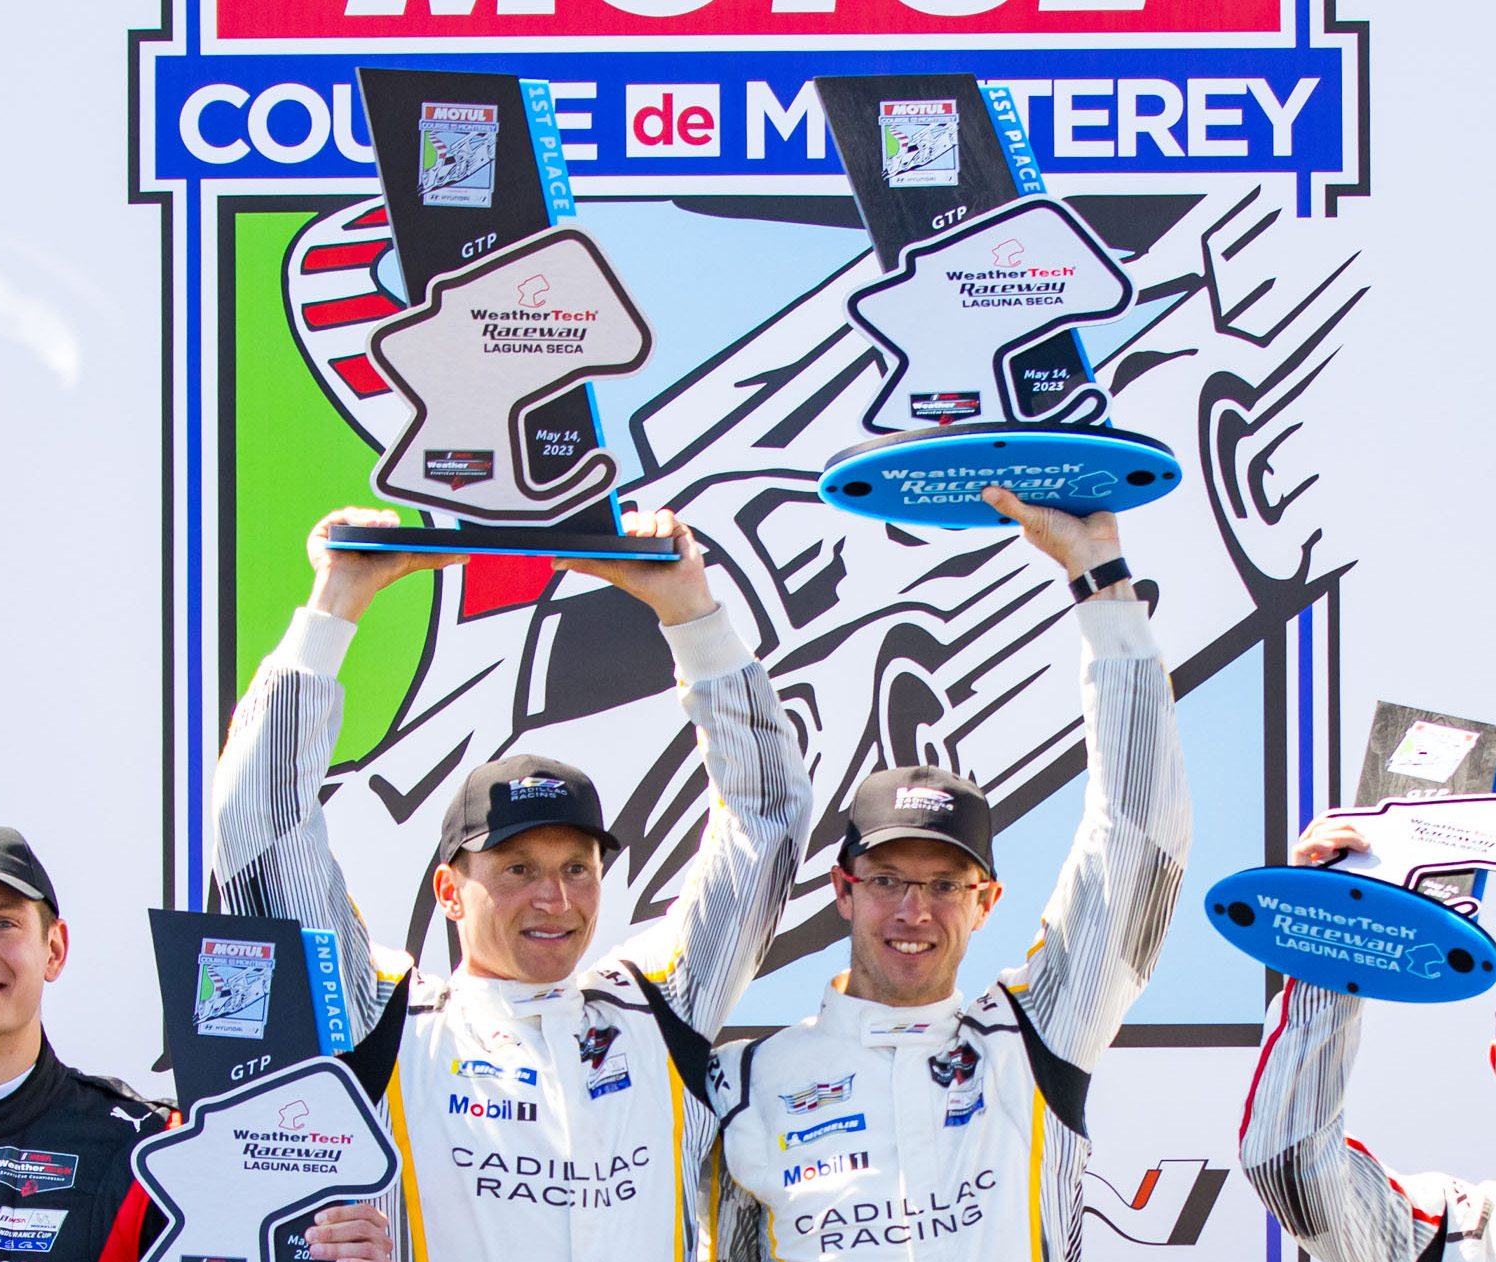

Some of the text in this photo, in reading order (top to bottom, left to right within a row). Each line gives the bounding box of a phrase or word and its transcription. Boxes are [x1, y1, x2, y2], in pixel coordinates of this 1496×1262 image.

[433, 107, 487, 121] MOTUL
[892, 104, 945, 116] MOTUL
[632, 92, 715, 147] de
[529, 86, 570, 210] 1ST PLACE
[988, 89, 1041, 192] 1ST PLACE
[931, 205, 967, 230] GTP
[461, 232, 497, 258] GTP
[946, 267, 1074, 281] WeatherTech
[959, 281, 1066, 298] Raceway
[962, 296, 1064, 308] LAGUNA SECA
[470, 309, 597, 322] WeatherTech
[481, 324, 587, 341] Raceway
[483, 343, 584, 354] LAGUNA SECA
[1023, 368, 1070, 380] May 14,
[1032, 381, 1064, 392] 2023
[536, 430, 581, 443] May 14,
[542, 445, 573, 456] 2023
[881, 463, 1082, 479] WeatherTech
[900, 477, 1065, 493] Raceway
[1257, 894, 1417, 940] WeatherTech
[1272, 914, 1404, 958] Raceway
[212, 943, 264, 957] MOTUL
[1275, 935, 1401, 973] LAGUNA SECA
[315, 935, 345, 1042] 2ND PLACE
[230, 1055, 271, 1081] GTP
[448, 1094, 512, 1120] Mobil
[233, 1128, 353, 1145] WeatherTech
[802, 1117, 859, 1142] MICHELIN
[242, 1142, 342, 1162] Raceway
[243, 1161, 338, 1174] LAGUNA SECA
[452, 1146, 649, 1181] CADILLAC
[783, 1155, 843, 1188] Mobil
[476, 1178, 637, 1208] RACING
[795, 1170, 996, 1235] CADILLAC
[36, 1231, 53, 1239] CUP
[820, 1205, 984, 1253] RACING
